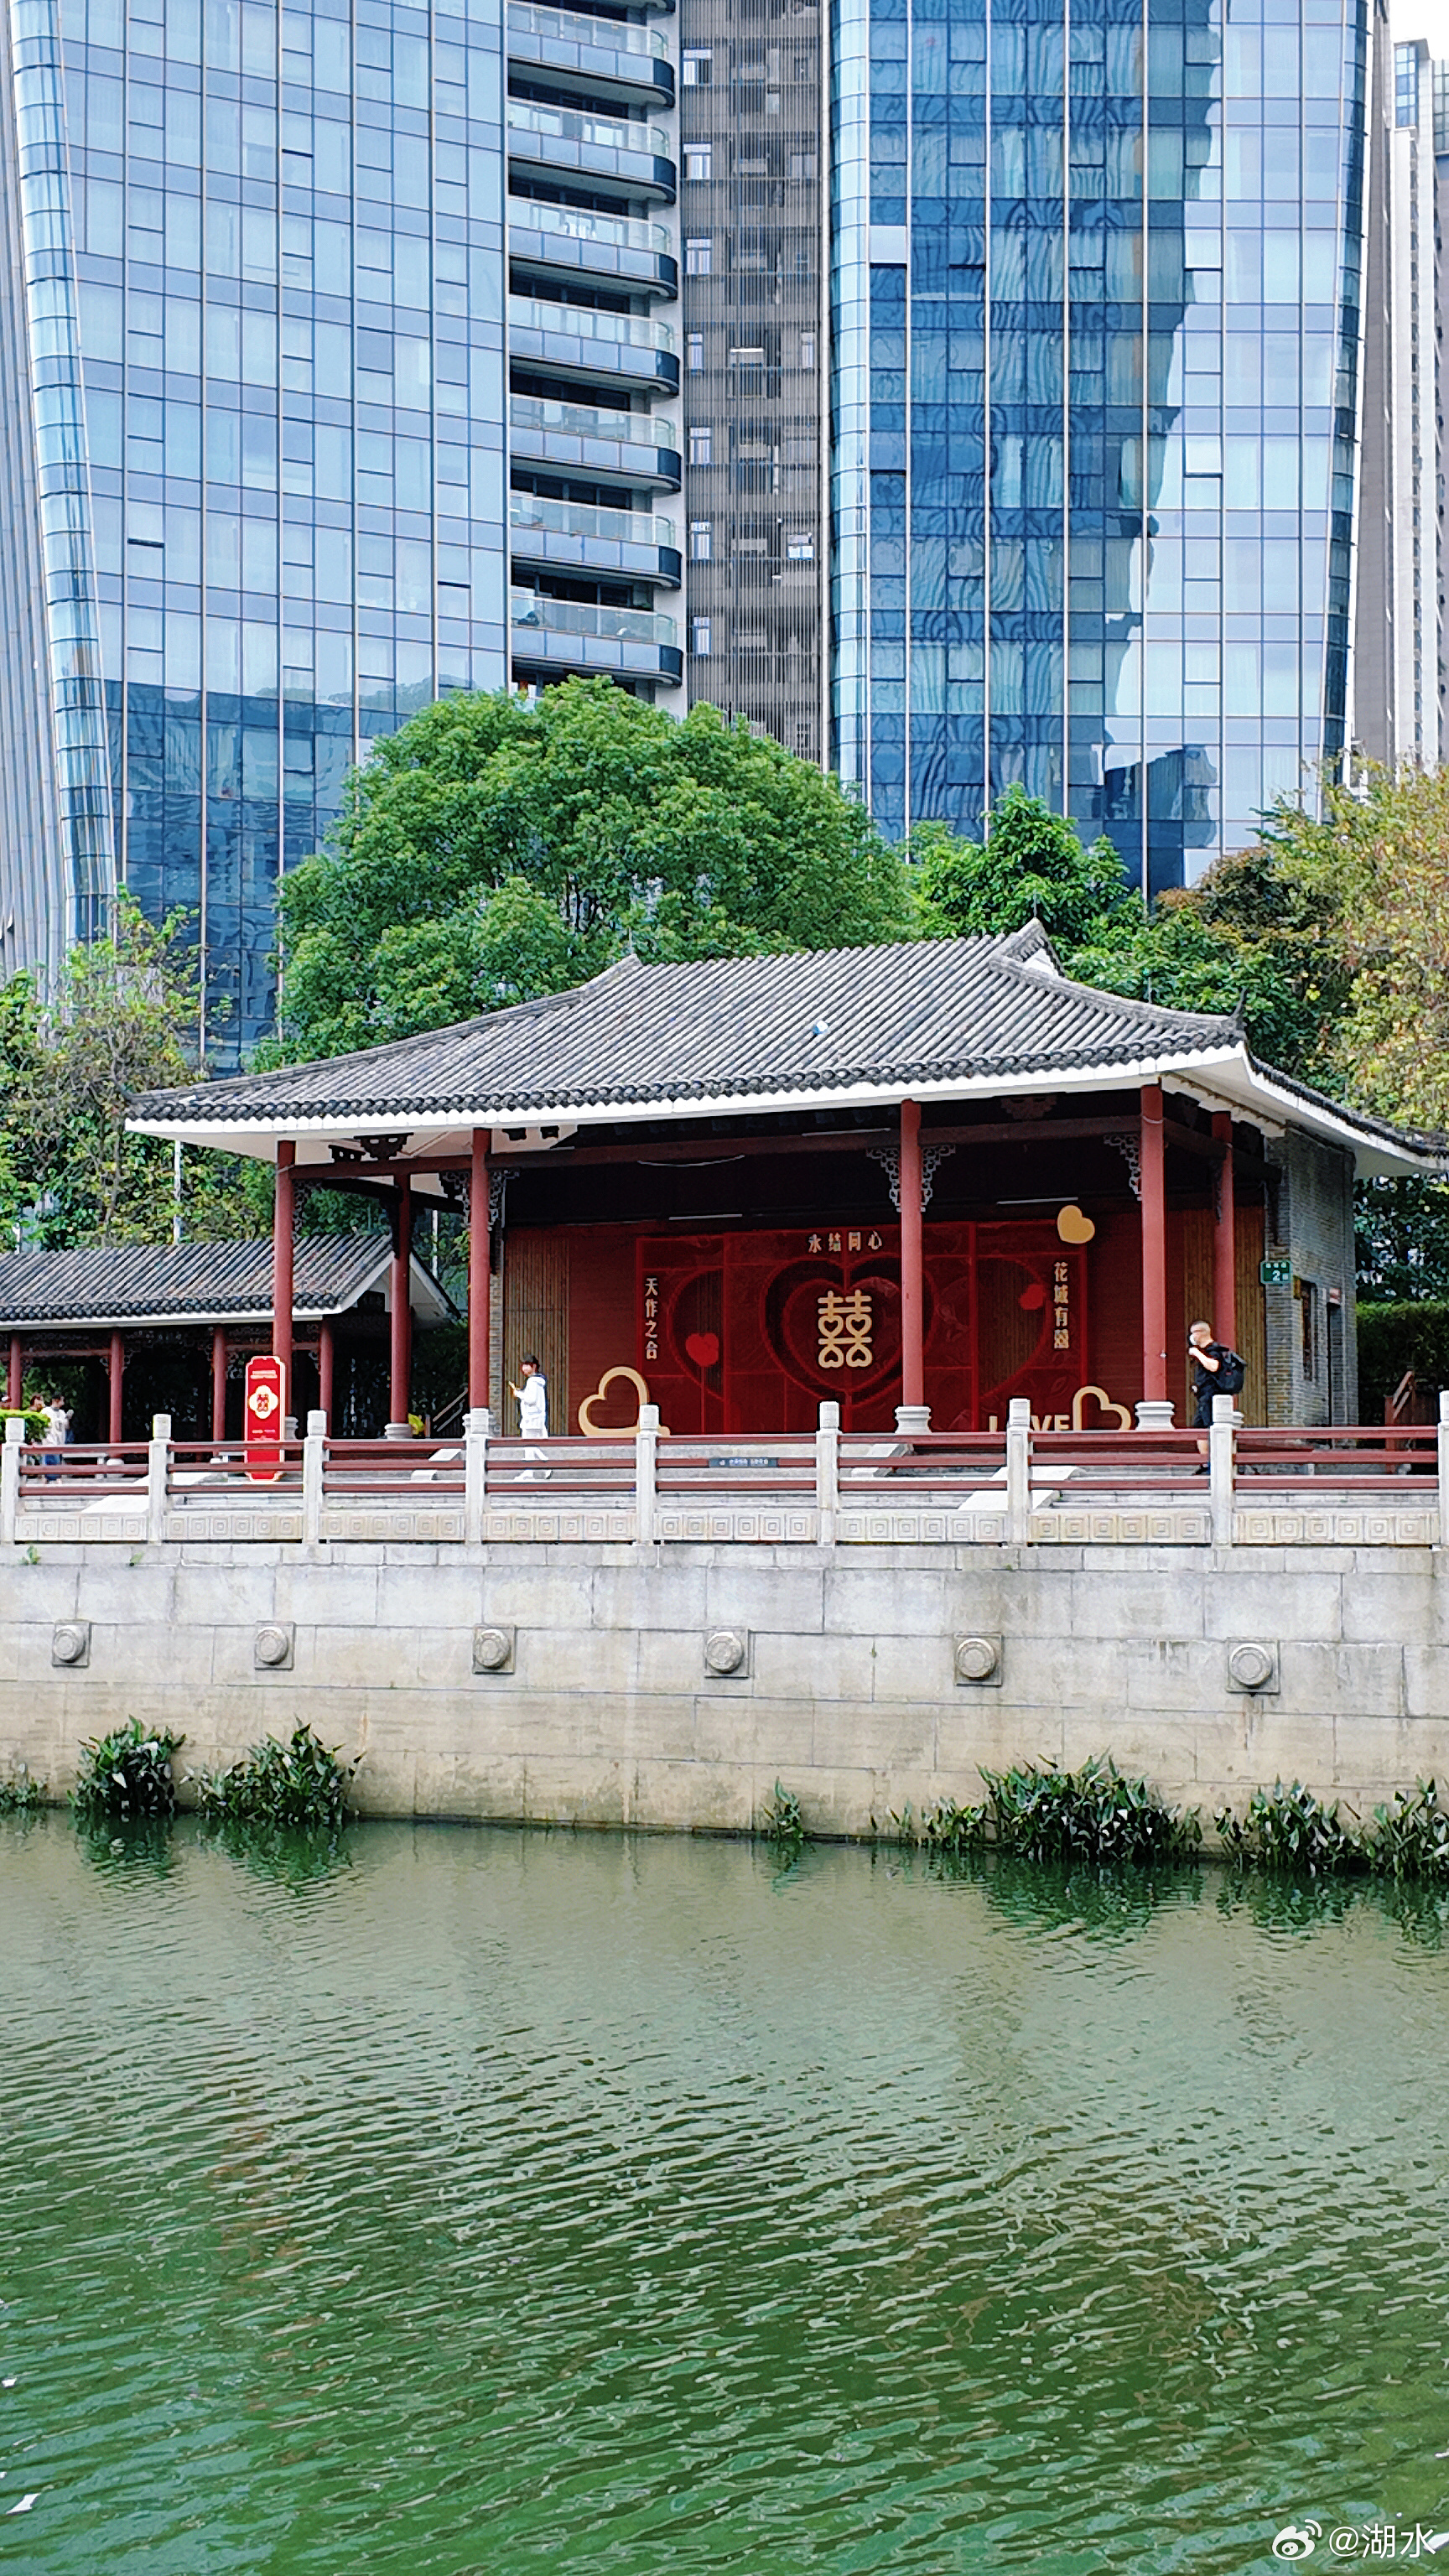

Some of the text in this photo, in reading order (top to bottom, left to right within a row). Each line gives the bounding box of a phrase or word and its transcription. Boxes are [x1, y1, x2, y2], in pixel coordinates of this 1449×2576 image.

[808, 1230, 883, 1254] 永结同心
[645, 1277, 658, 1360] 天作之合
[989, 1414, 1071, 1431] LVE
